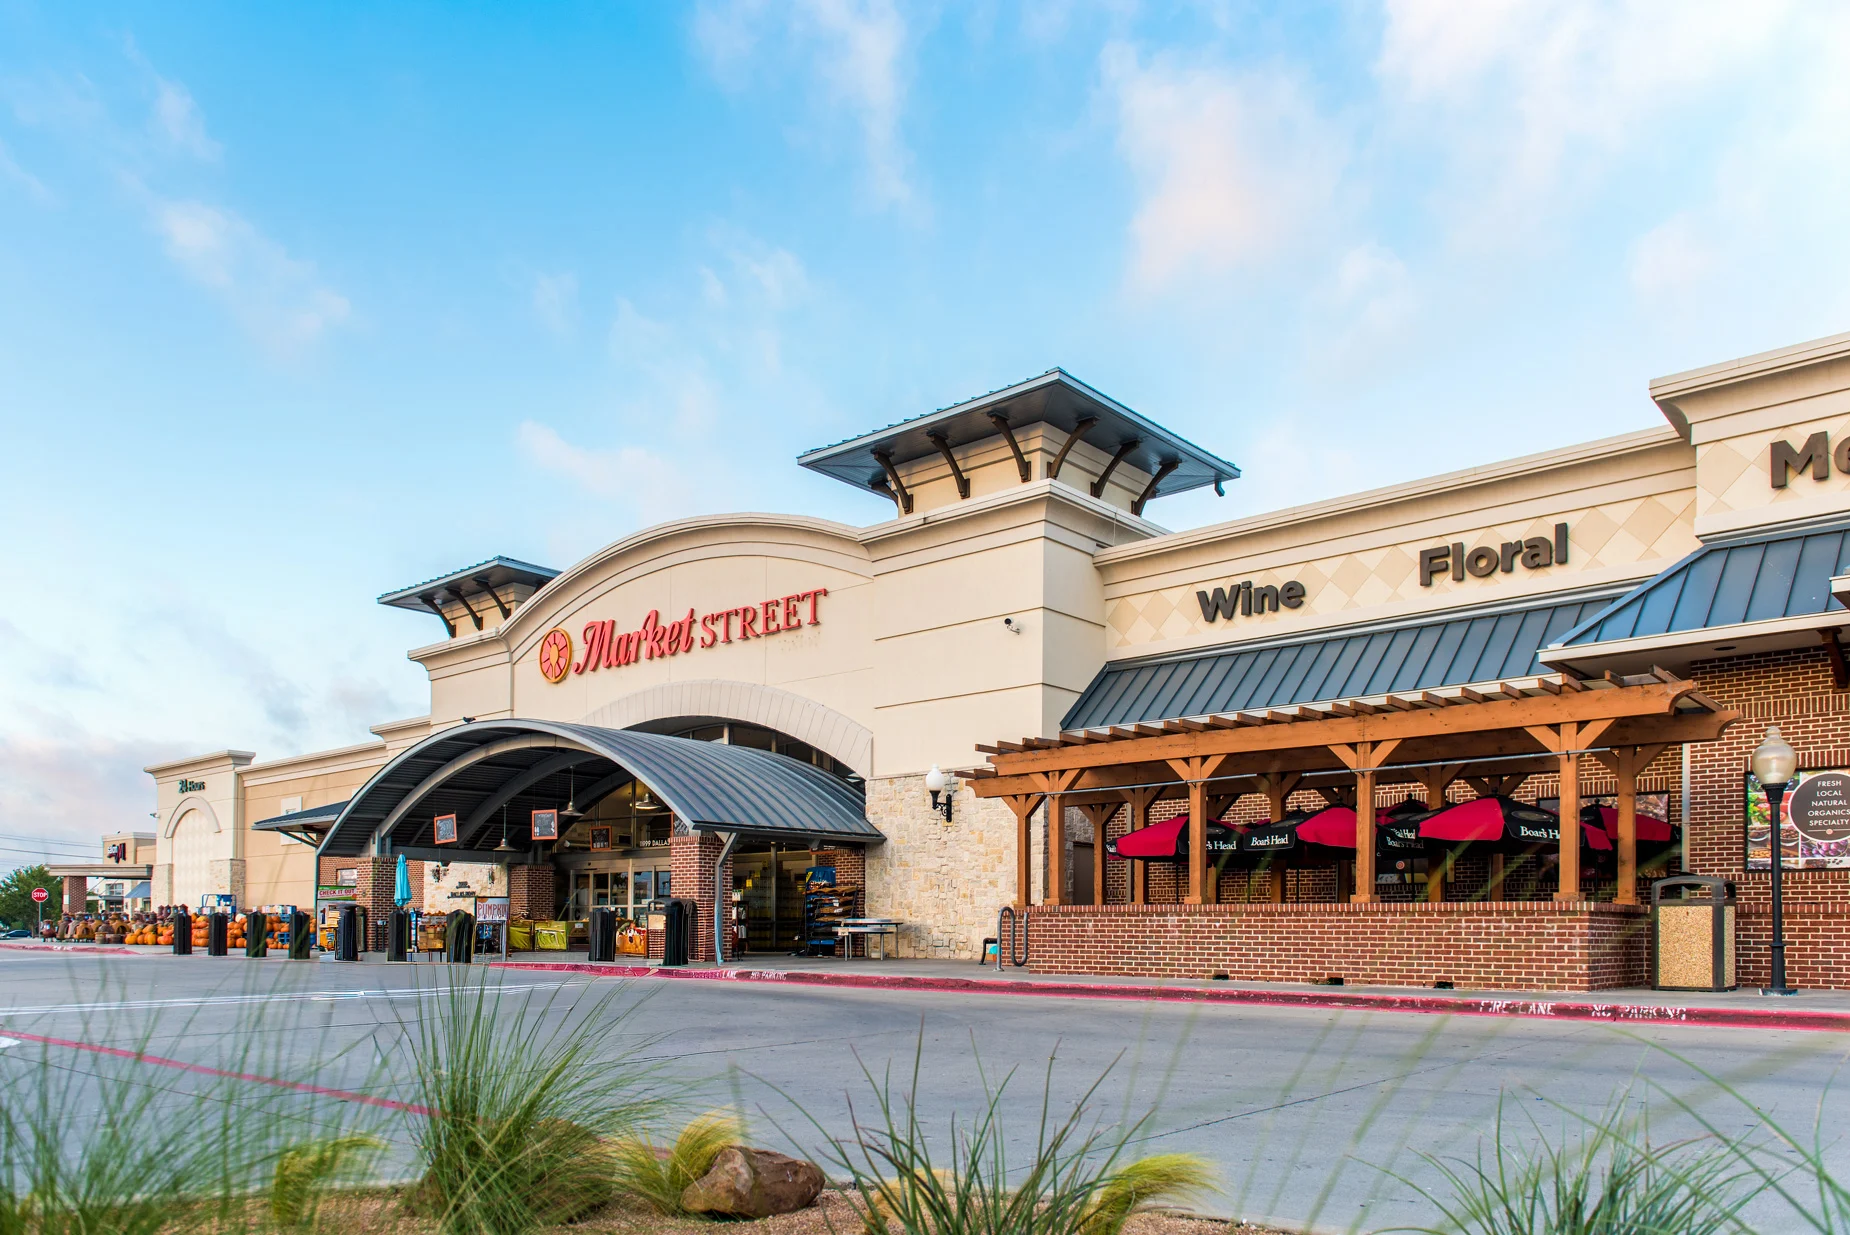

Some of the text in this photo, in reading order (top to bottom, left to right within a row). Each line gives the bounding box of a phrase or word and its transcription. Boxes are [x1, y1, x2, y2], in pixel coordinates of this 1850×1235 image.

[1419, 522, 1568, 586] Floral
[1197, 580, 1305, 623] Wine
[572, 588, 828, 675] Market STREET
[178, 778, 206, 794] 24 Hours
[1811, 799, 1848, 807] NATURAL
[1807, 809, 1850, 817] ORGANICS
[1520, 825, 1547, 839] Boar's
[1214, 840, 1237, 850] Head
[1251, 834, 1288, 846] Boar's Head
[1518, 1002, 1556, 1016] LANE
[1620, 1005, 1687, 1021] PARKING
